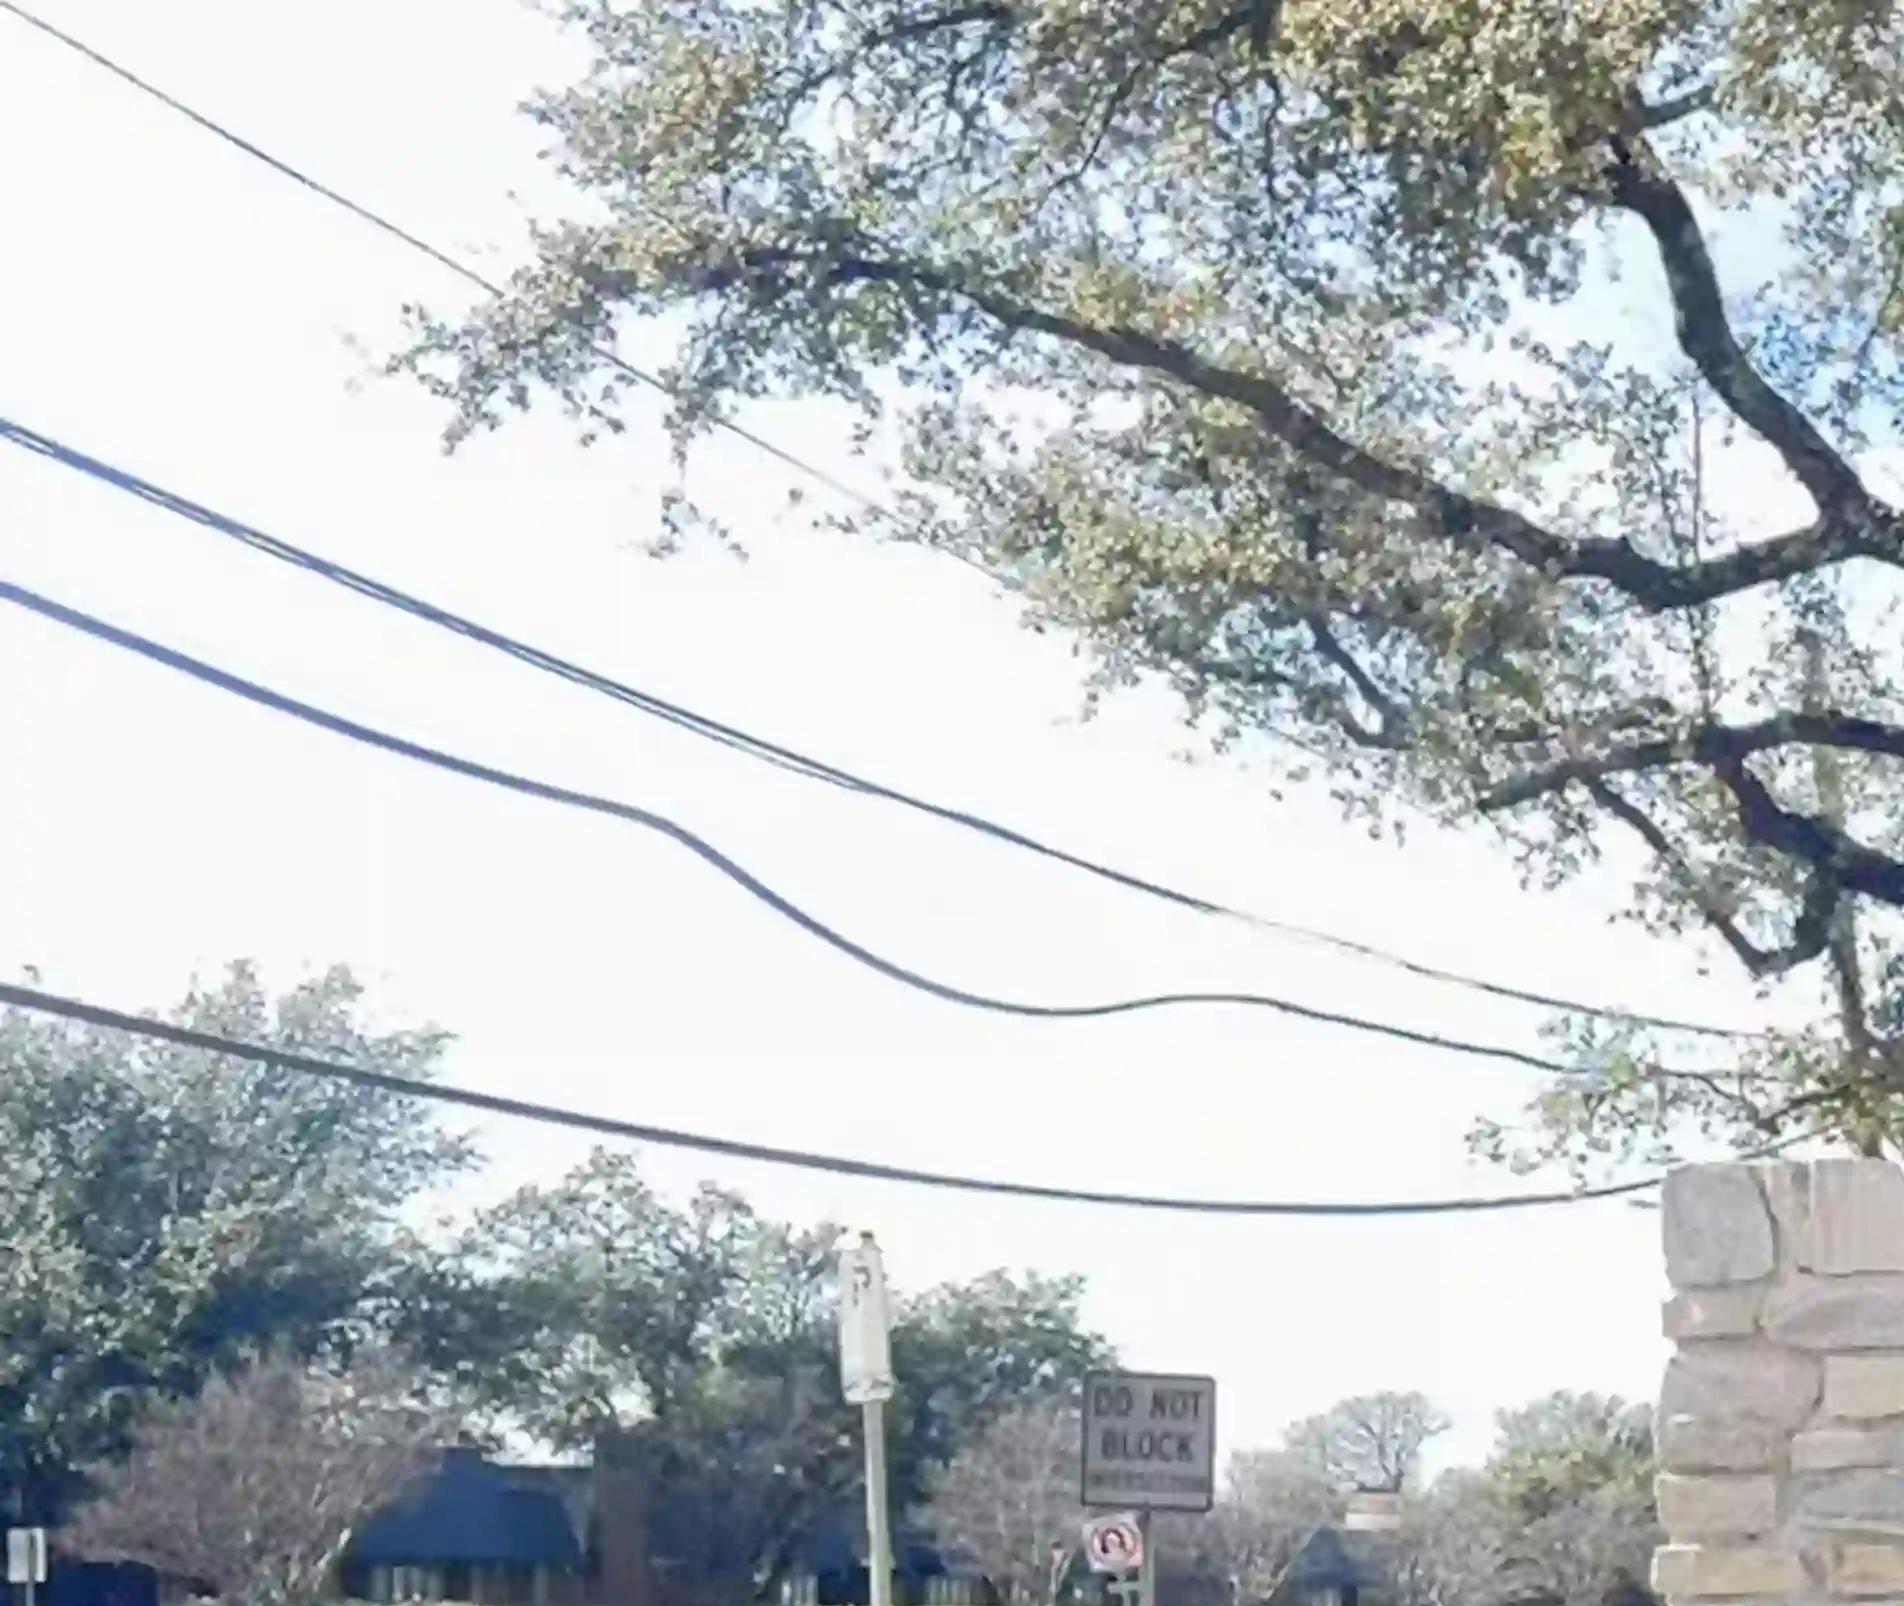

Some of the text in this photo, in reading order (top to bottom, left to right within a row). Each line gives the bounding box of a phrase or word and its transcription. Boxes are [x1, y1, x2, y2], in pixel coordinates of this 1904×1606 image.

[1093, 1386, 1204, 1420] DO NOT
[1101, 1429, 1195, 1462] BLOCK
